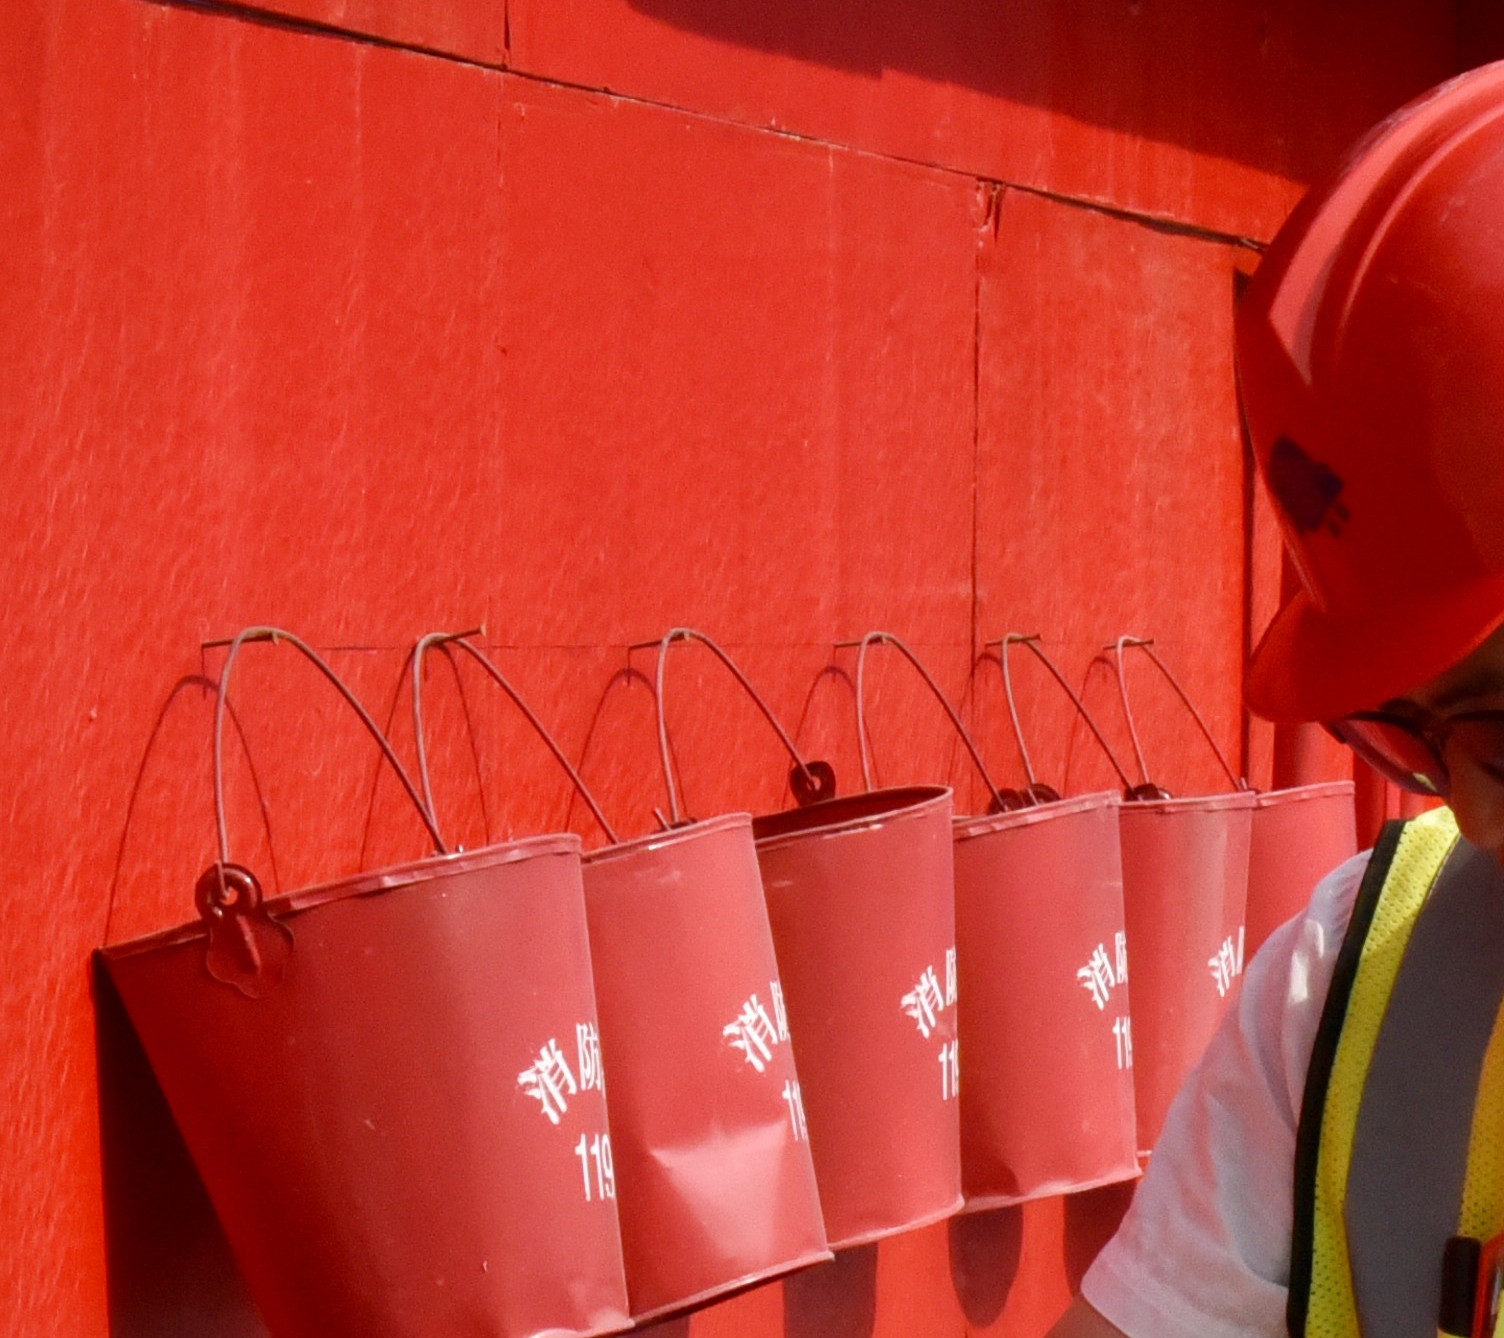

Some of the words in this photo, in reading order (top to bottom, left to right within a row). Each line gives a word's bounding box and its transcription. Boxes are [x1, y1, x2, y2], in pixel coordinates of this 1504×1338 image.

[1208, 926, 1246, 998] 消
[516, 1021, 605, 1125] 消防
[574, 1133, 616, 1202] 119
